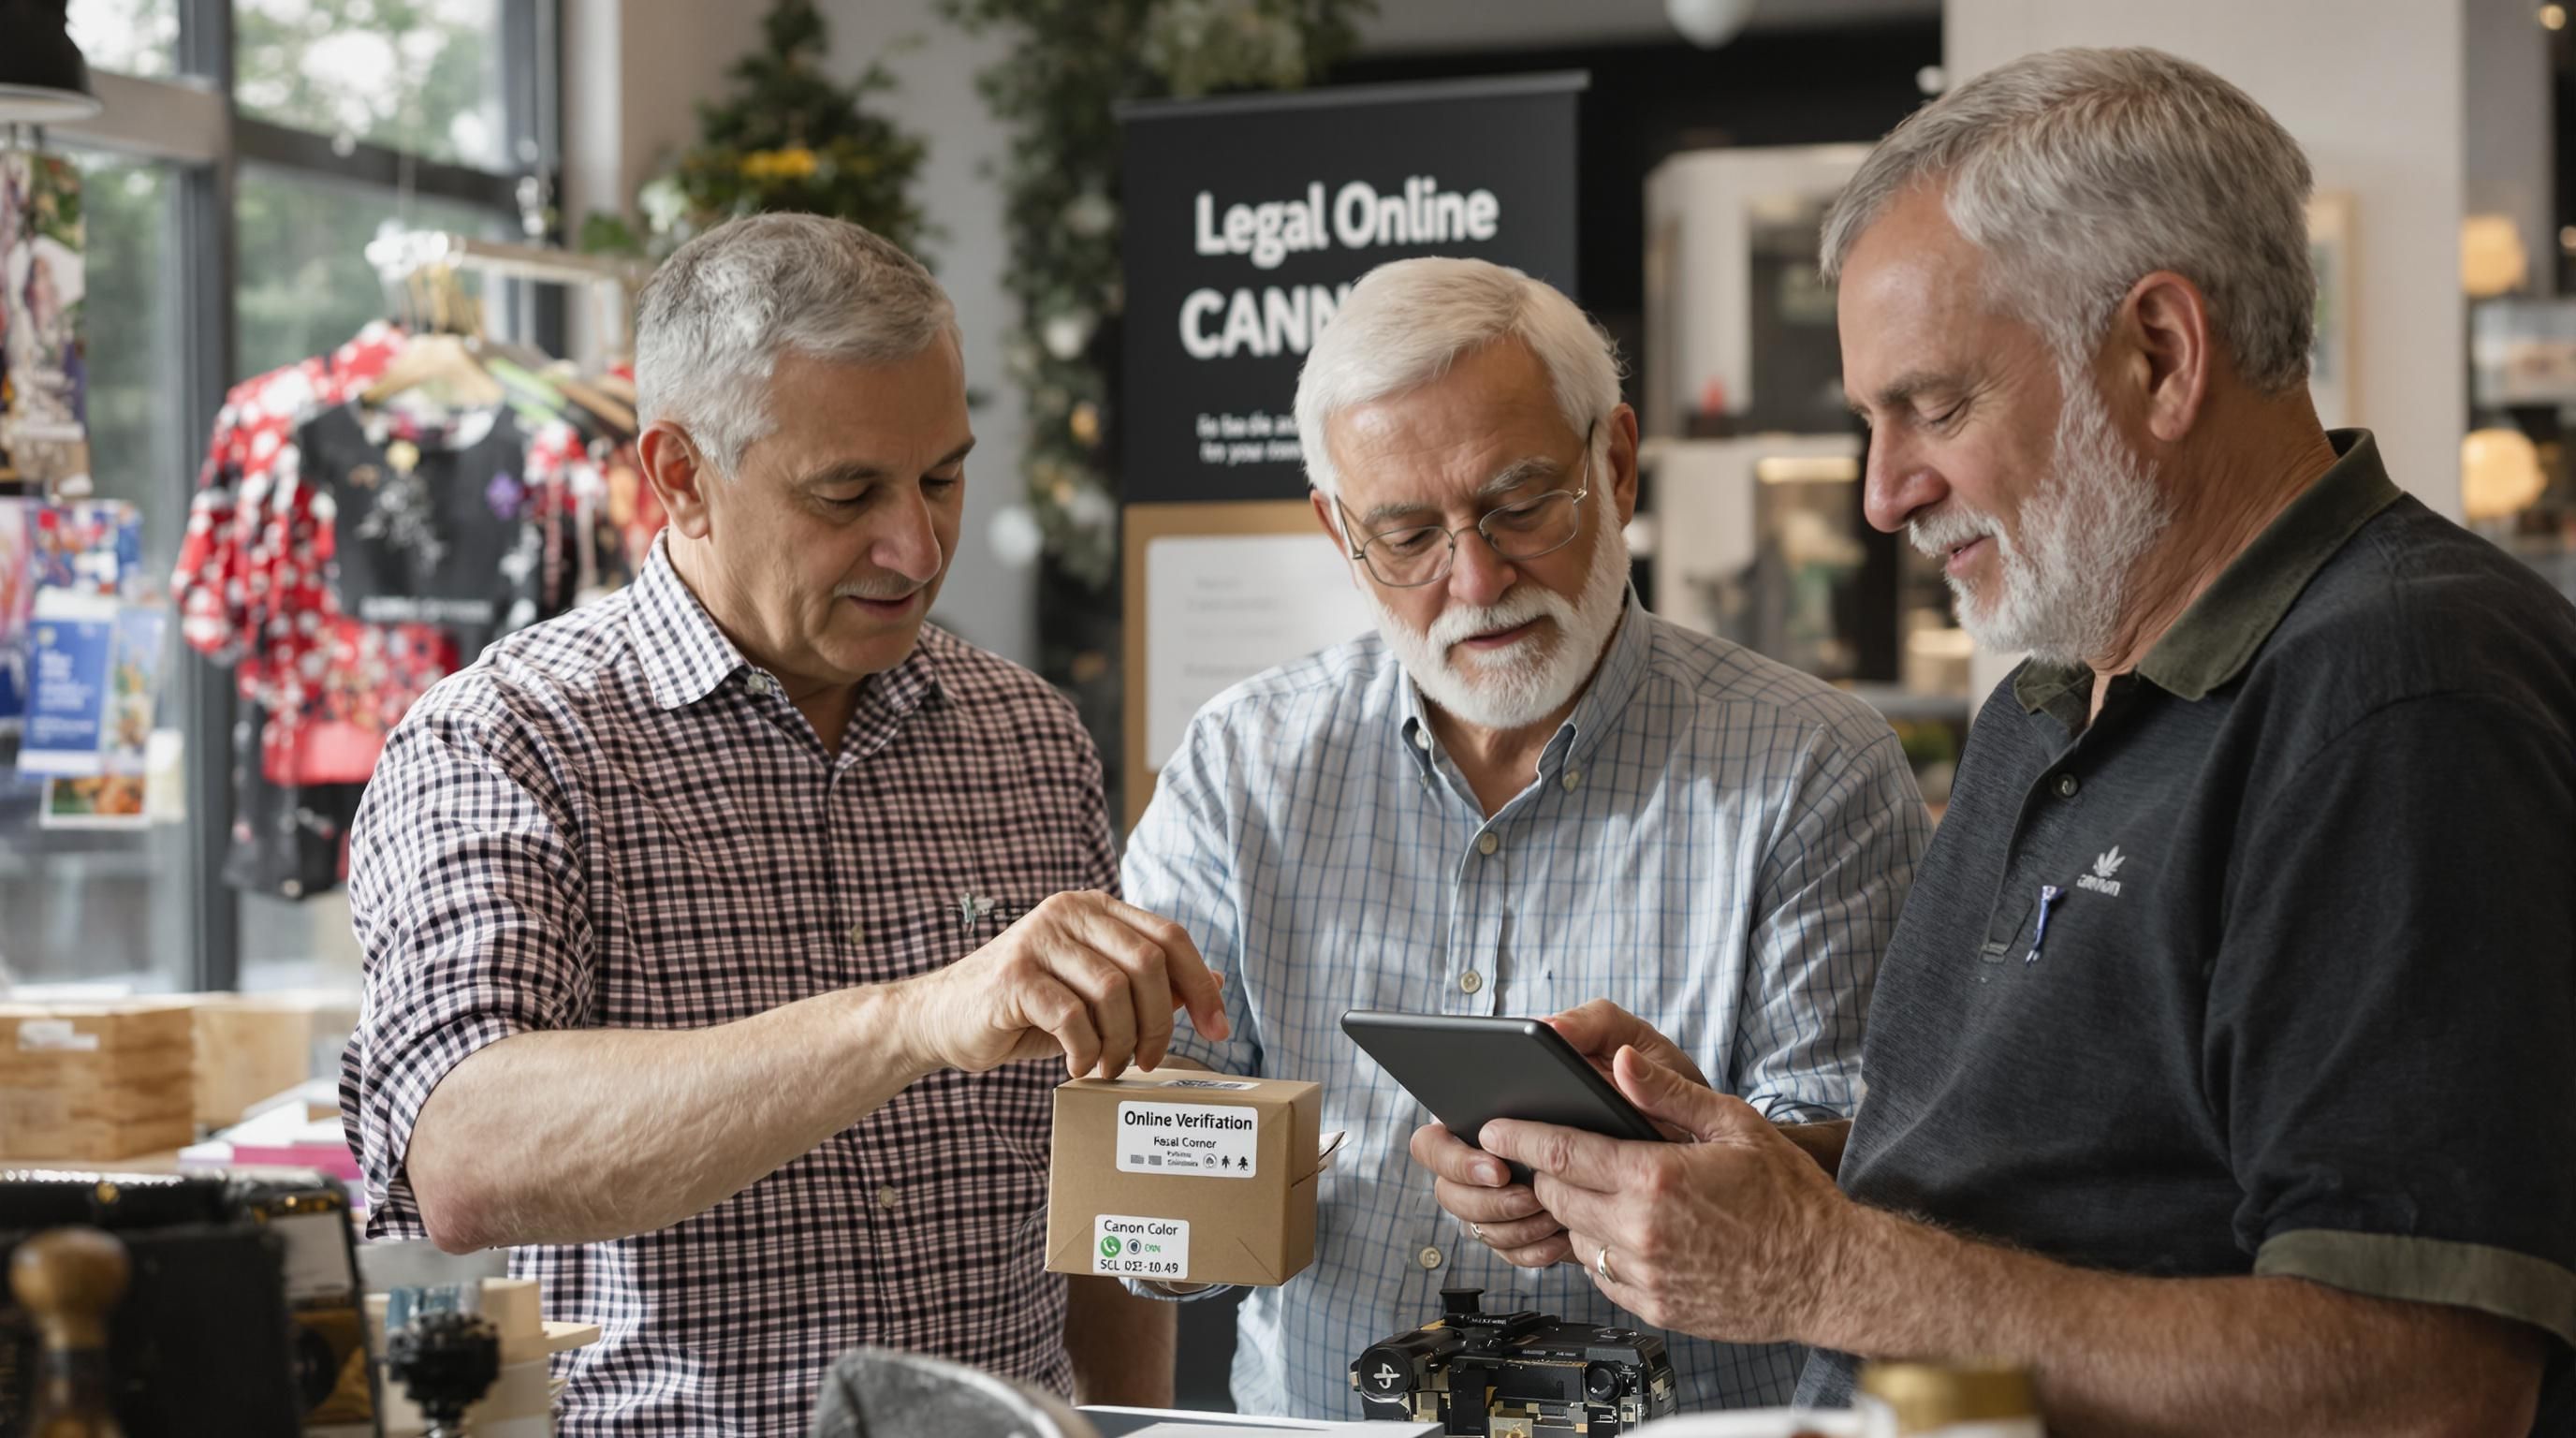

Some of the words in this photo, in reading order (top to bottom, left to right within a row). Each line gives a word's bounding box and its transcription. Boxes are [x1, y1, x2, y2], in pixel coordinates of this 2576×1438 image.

[1194, 181, 1328, 269] Legal
[1334, 175, 1500, 249] Online
[1124, 1110, 1172, 1127] Online
[1104, 1220, 1144, 1234] Canon
[1148, 1223, 1178, 1236] Color
